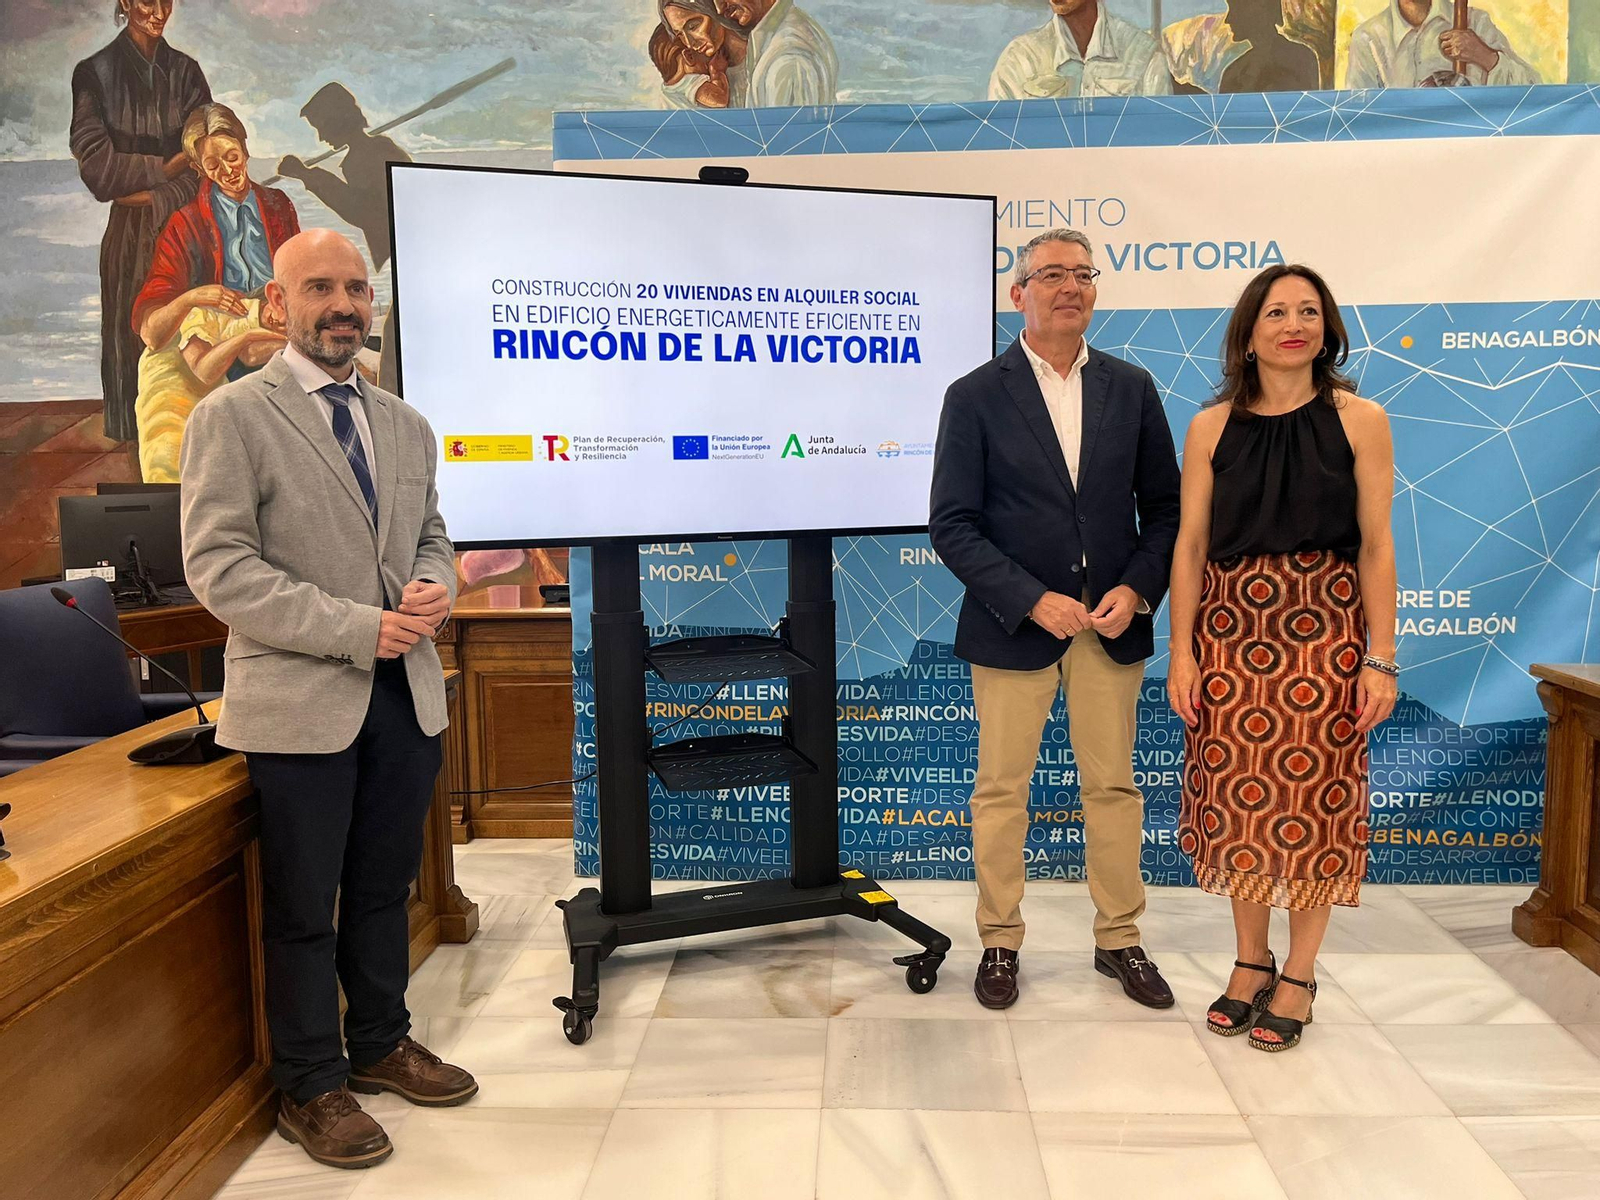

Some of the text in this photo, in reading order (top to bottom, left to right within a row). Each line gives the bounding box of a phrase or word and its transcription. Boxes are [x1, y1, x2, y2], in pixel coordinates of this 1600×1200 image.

[1105, 240, 1285, 271] VICTORIA
[492, 279, 920, 306] CONSTRUCCIÓN 20 VIVIENDAS EN ALQUILER SOCIAL
[492, 304, 921, 331] EN EDIFICIO ENERGETICAMENTE EFICIENTE EN
[493, 325, 921, 364] RINCÓN DE LA VICTORIA
[1441, 325, 1600, 350] BENAGALBÓN
[573, 435, 666, 444] Plan de Recuperación,
[573, 444, 639, 452] Transformación
[751, 435, 763, 444] por
[808, 435, 834, 444] Junta
[807, 444, 867, 454] de Andalucía
[649, 564, 728, 582] MORAL
[1439, 590, 1471, 608] DE
